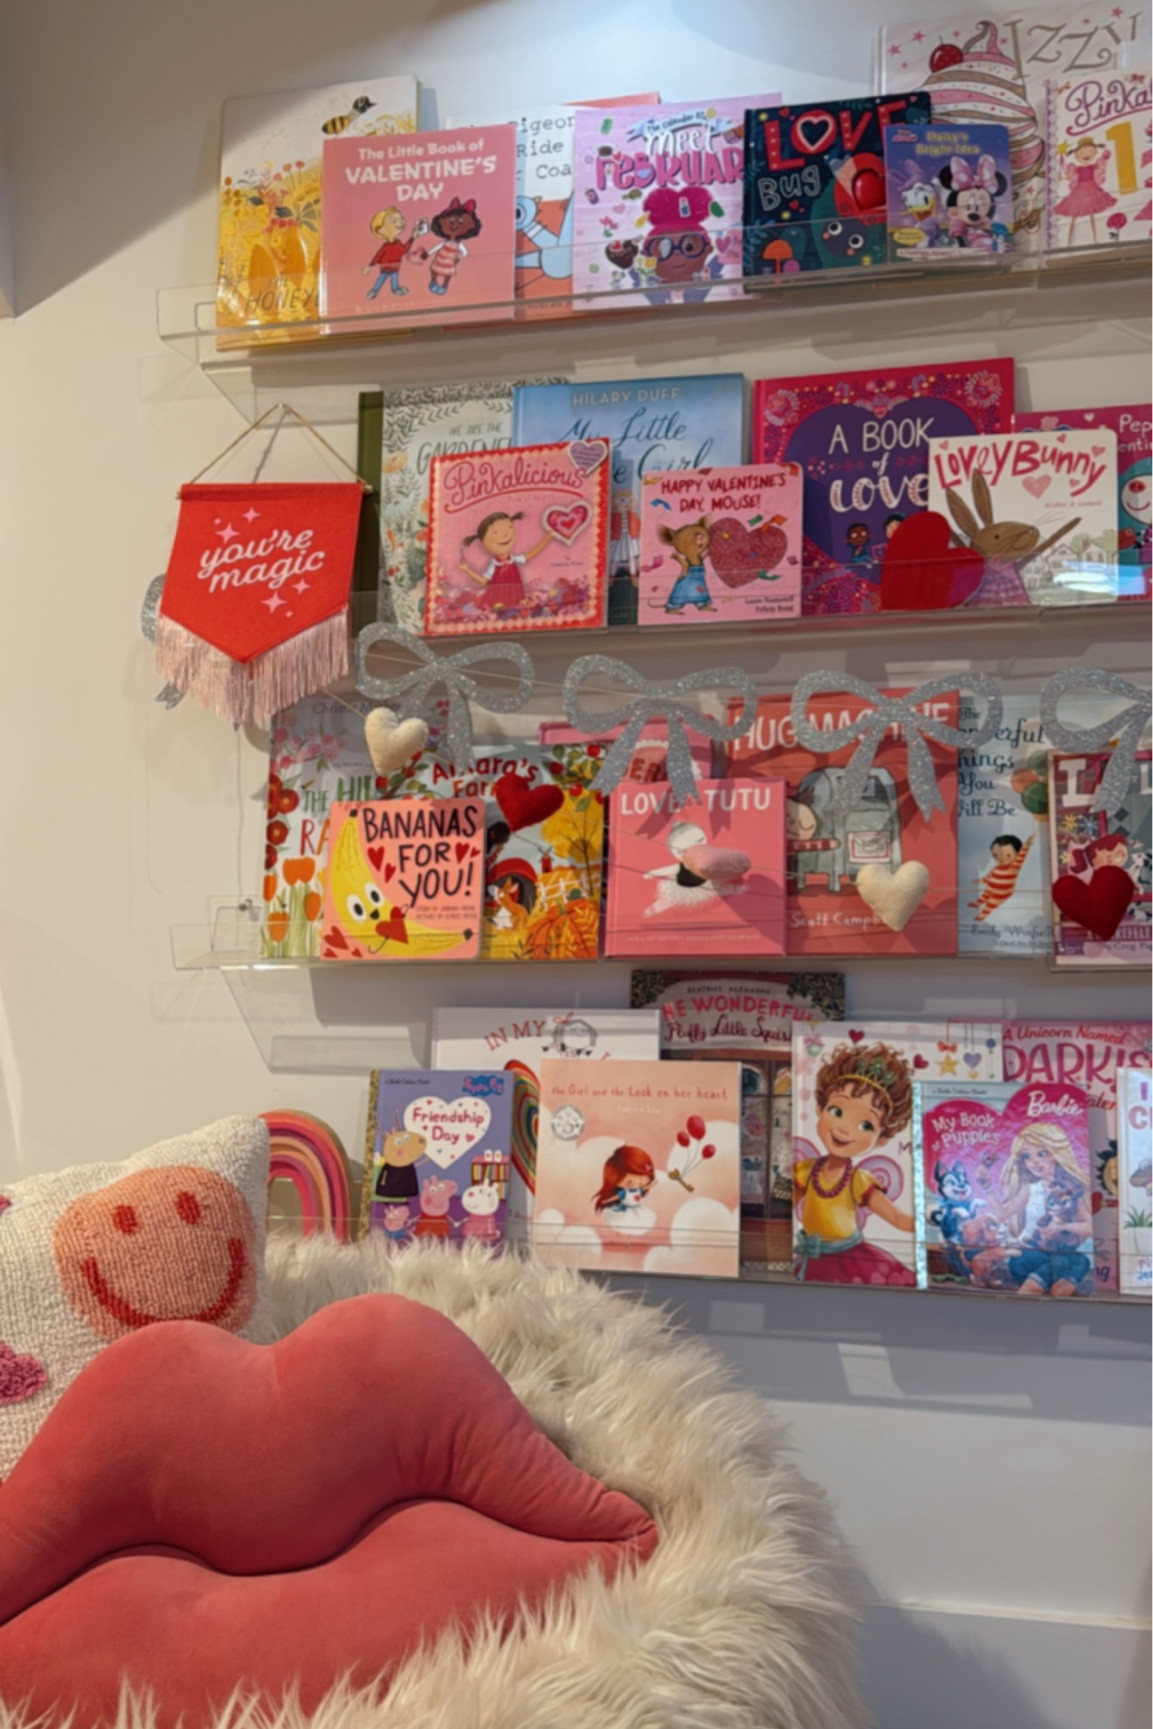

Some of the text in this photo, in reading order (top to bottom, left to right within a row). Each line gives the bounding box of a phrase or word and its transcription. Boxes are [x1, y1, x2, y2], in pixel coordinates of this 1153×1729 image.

[1065, 79, 1152, 127] Pinka
[508, 117, 575, 136] igeo
[359, 138, 485, 161] The Little Book of
[345, 155, 497, 185] VALENTINE'S
[396, 182, 444, 202] DAY
[758, 164, 822, 211] Bug
[572, 387, 681, 407] HILARY DUFF
[611, 406, 688, 449] Little
[828, 416, 935, 455] A BOOK
[872, 451, 890, 476] of
[443, 455, 587, 505] Pinkalicious
[662, 479, 702, 495] HAPPY
[711, 493, 762, 512] MOUSE!
[197, 528, 314, 579] you're
[208, 549, 326, 594] magic
[958, 771, 997, 797] You
[303, 789, 330, 813] THE
[703, 787, 771, 812] TUTU
[986, 798, 1017, 817] Be
[363, 804, 478, 844] BANANAS
[398, 841, 451, 873] FOR
[398, 861, 474, 909] YOU!
[790, 911, 828, 928] Scott
[482, 1026, 509, 1051] IN
[511, 1019, 547, 1040] MY
[1003, 1024, 1129, 1045] A Unicorn Named
[568, 1084, 588, 1096] Girl
[674, 1085, 691, 1099] her
[696, 1085, 728, 1100] heart
[1026, 1089, 1083, 1118] Barbie
[412, 1106, 485, 1129] Friendship
[931, 1111, 996, 1133] My Book
[431, 1125, 460, 1145] Day
[942, 1129, 1001, 1147] Puppies
